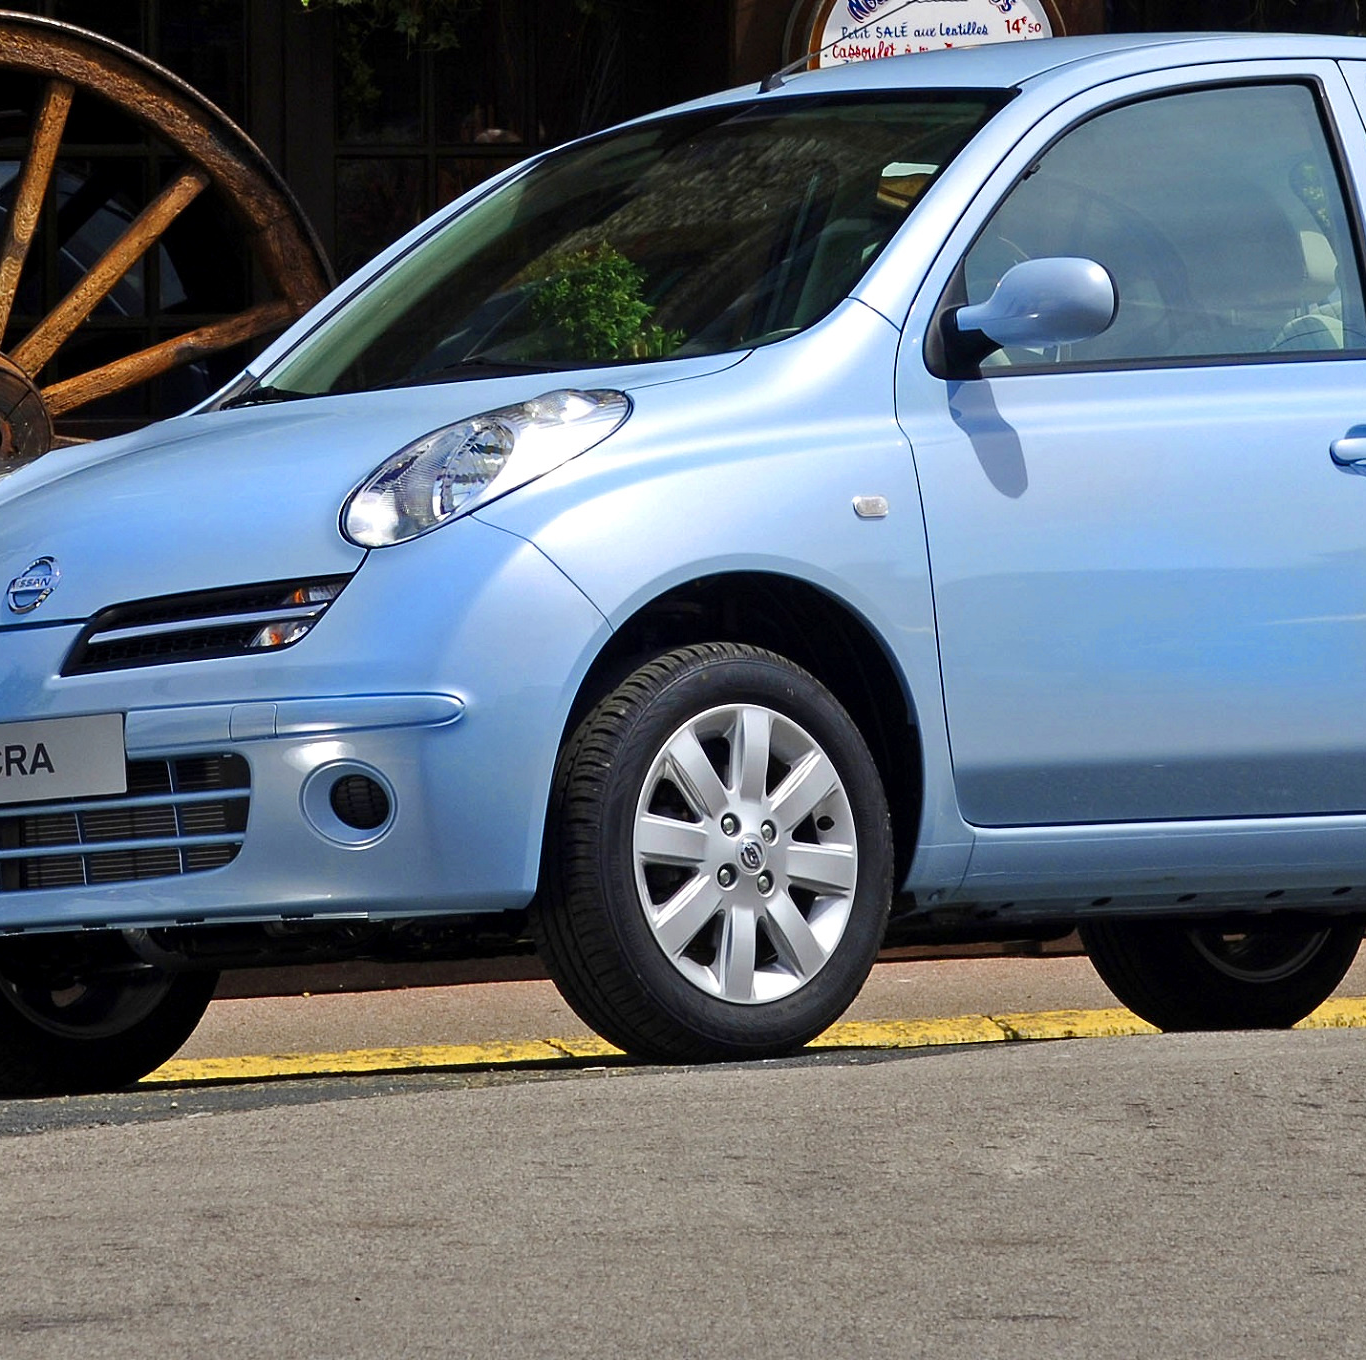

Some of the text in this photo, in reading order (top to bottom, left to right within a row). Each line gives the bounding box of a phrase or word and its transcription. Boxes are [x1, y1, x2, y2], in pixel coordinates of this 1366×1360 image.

[840, 26, 871, 40] Petit
[875, 21, 909, 39] SALÉ
[913, 27, 937, 39] aux
